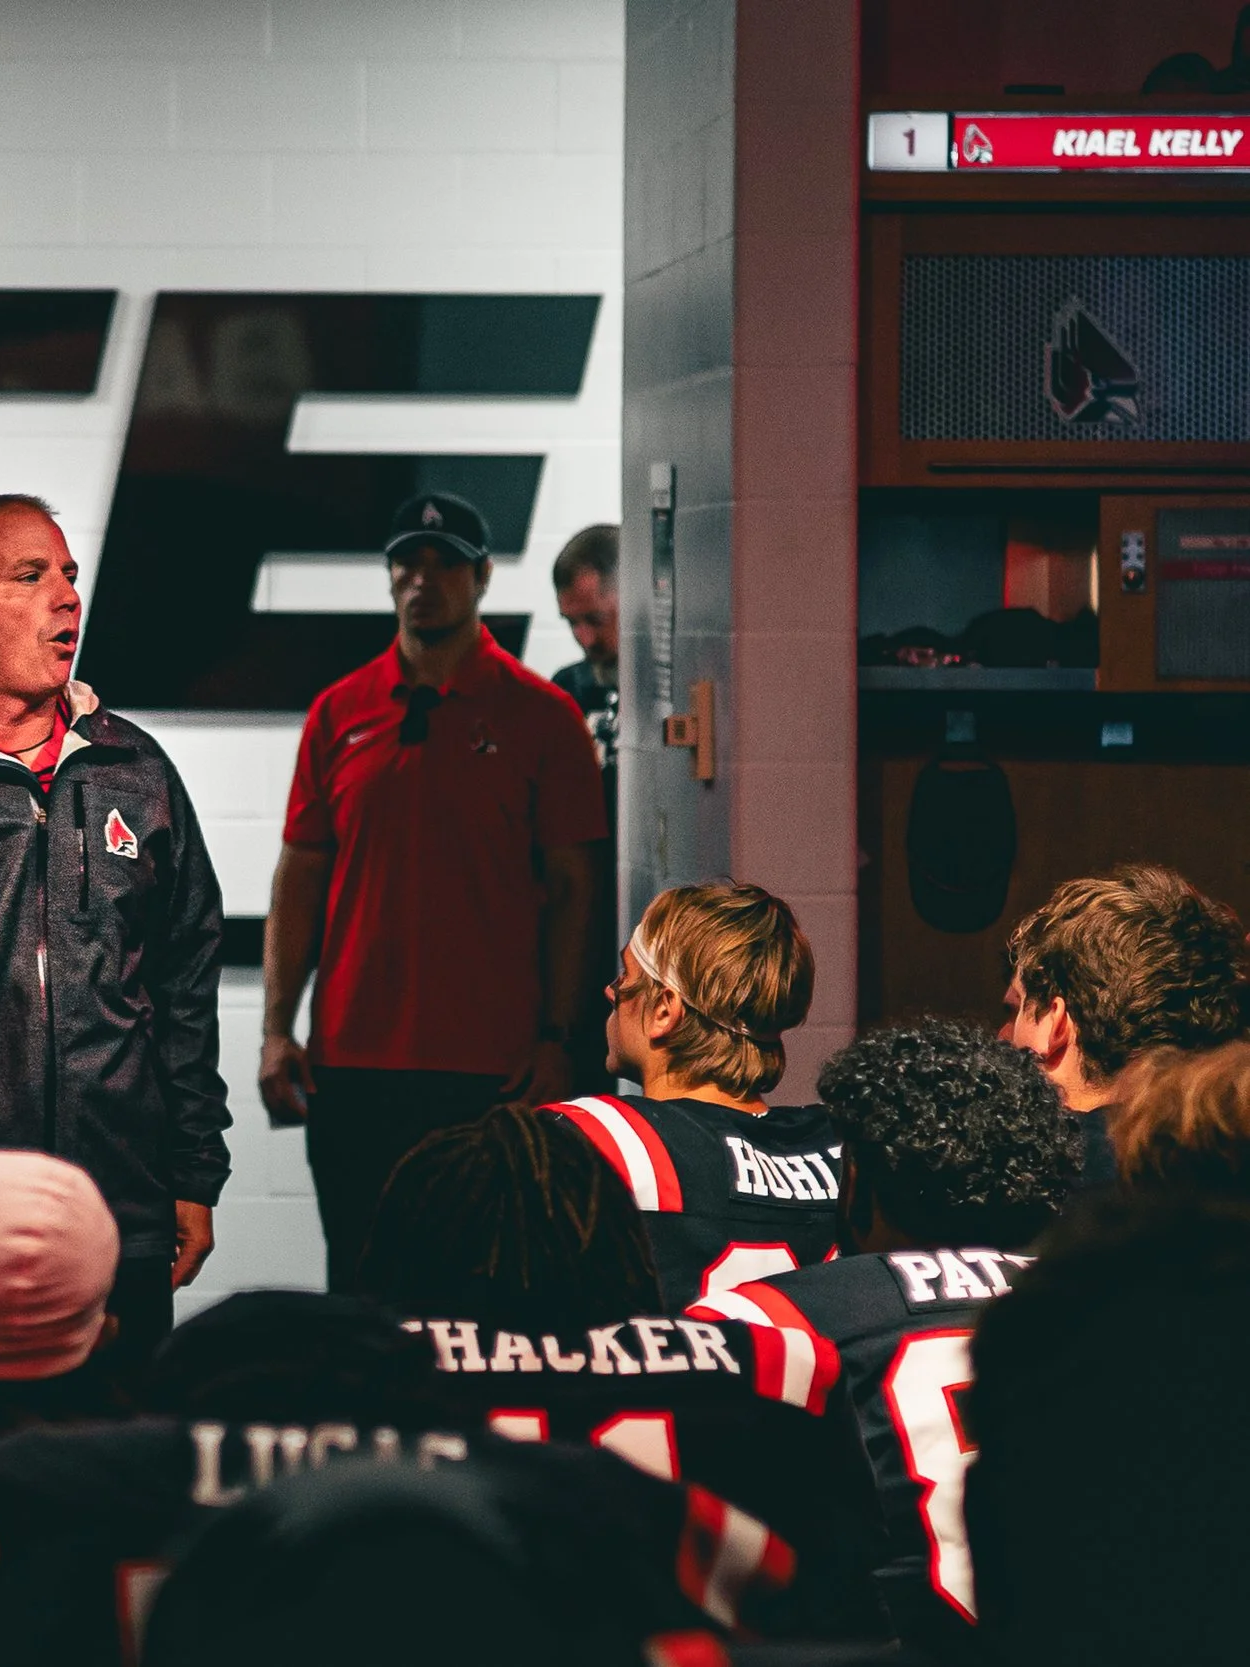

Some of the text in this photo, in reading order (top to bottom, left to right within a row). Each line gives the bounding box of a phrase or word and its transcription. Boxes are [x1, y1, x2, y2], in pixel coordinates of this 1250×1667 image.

[903, 128, 917, 157] 1
[1052, 129, 1244, 157] KIAEL KELLY
[887, 1249, 1041, 1303] PAT
[398, 1317, 742, 1375] HACKER
